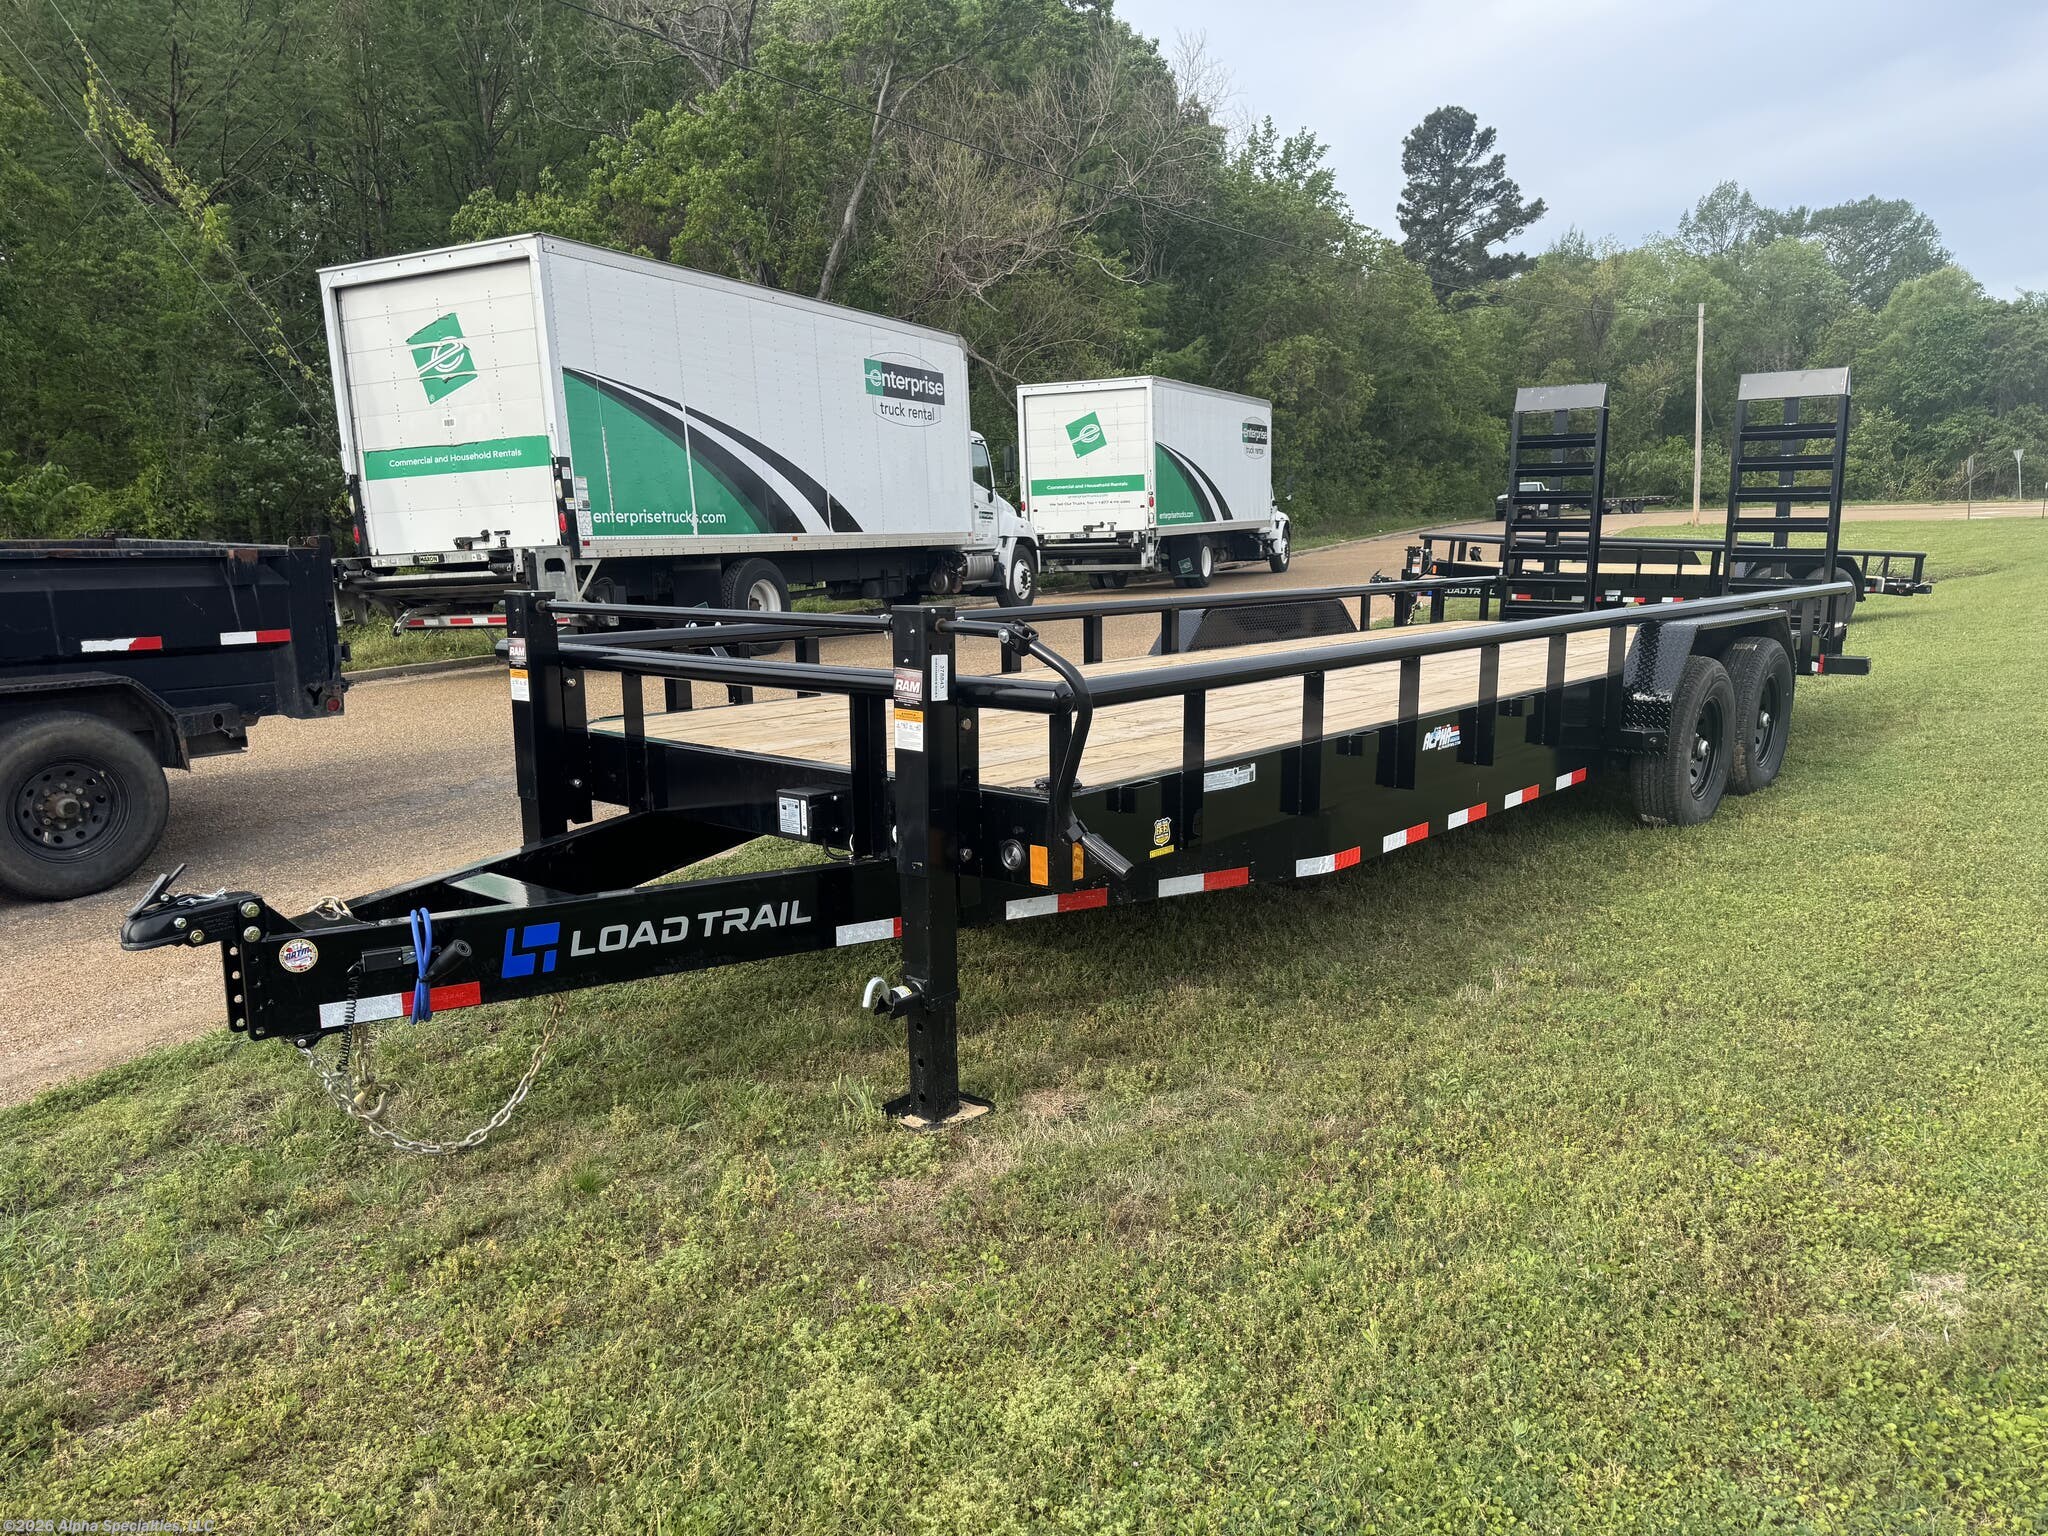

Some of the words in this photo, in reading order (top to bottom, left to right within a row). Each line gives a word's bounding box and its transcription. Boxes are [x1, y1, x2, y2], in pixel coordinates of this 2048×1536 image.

[865, 369, 944, 396] enterprise
[880, 402, 905, 417] truck
[908, 407, 935, 421] rental
[389, 456, 433, 467] Commercial
[434, 455, 448, 463] and
[450, 451, 491, 461] Household
[492, 448, 522, 458] Rentals
[593, 509, 727, 526] enterprisetrucks.com
[1468, 587, 1495, 595] TRL
[895, 678, 920, 693] RAM
[571, 916, 689, 957] LOAD
[698, 900, 812, 937] TRAIL
